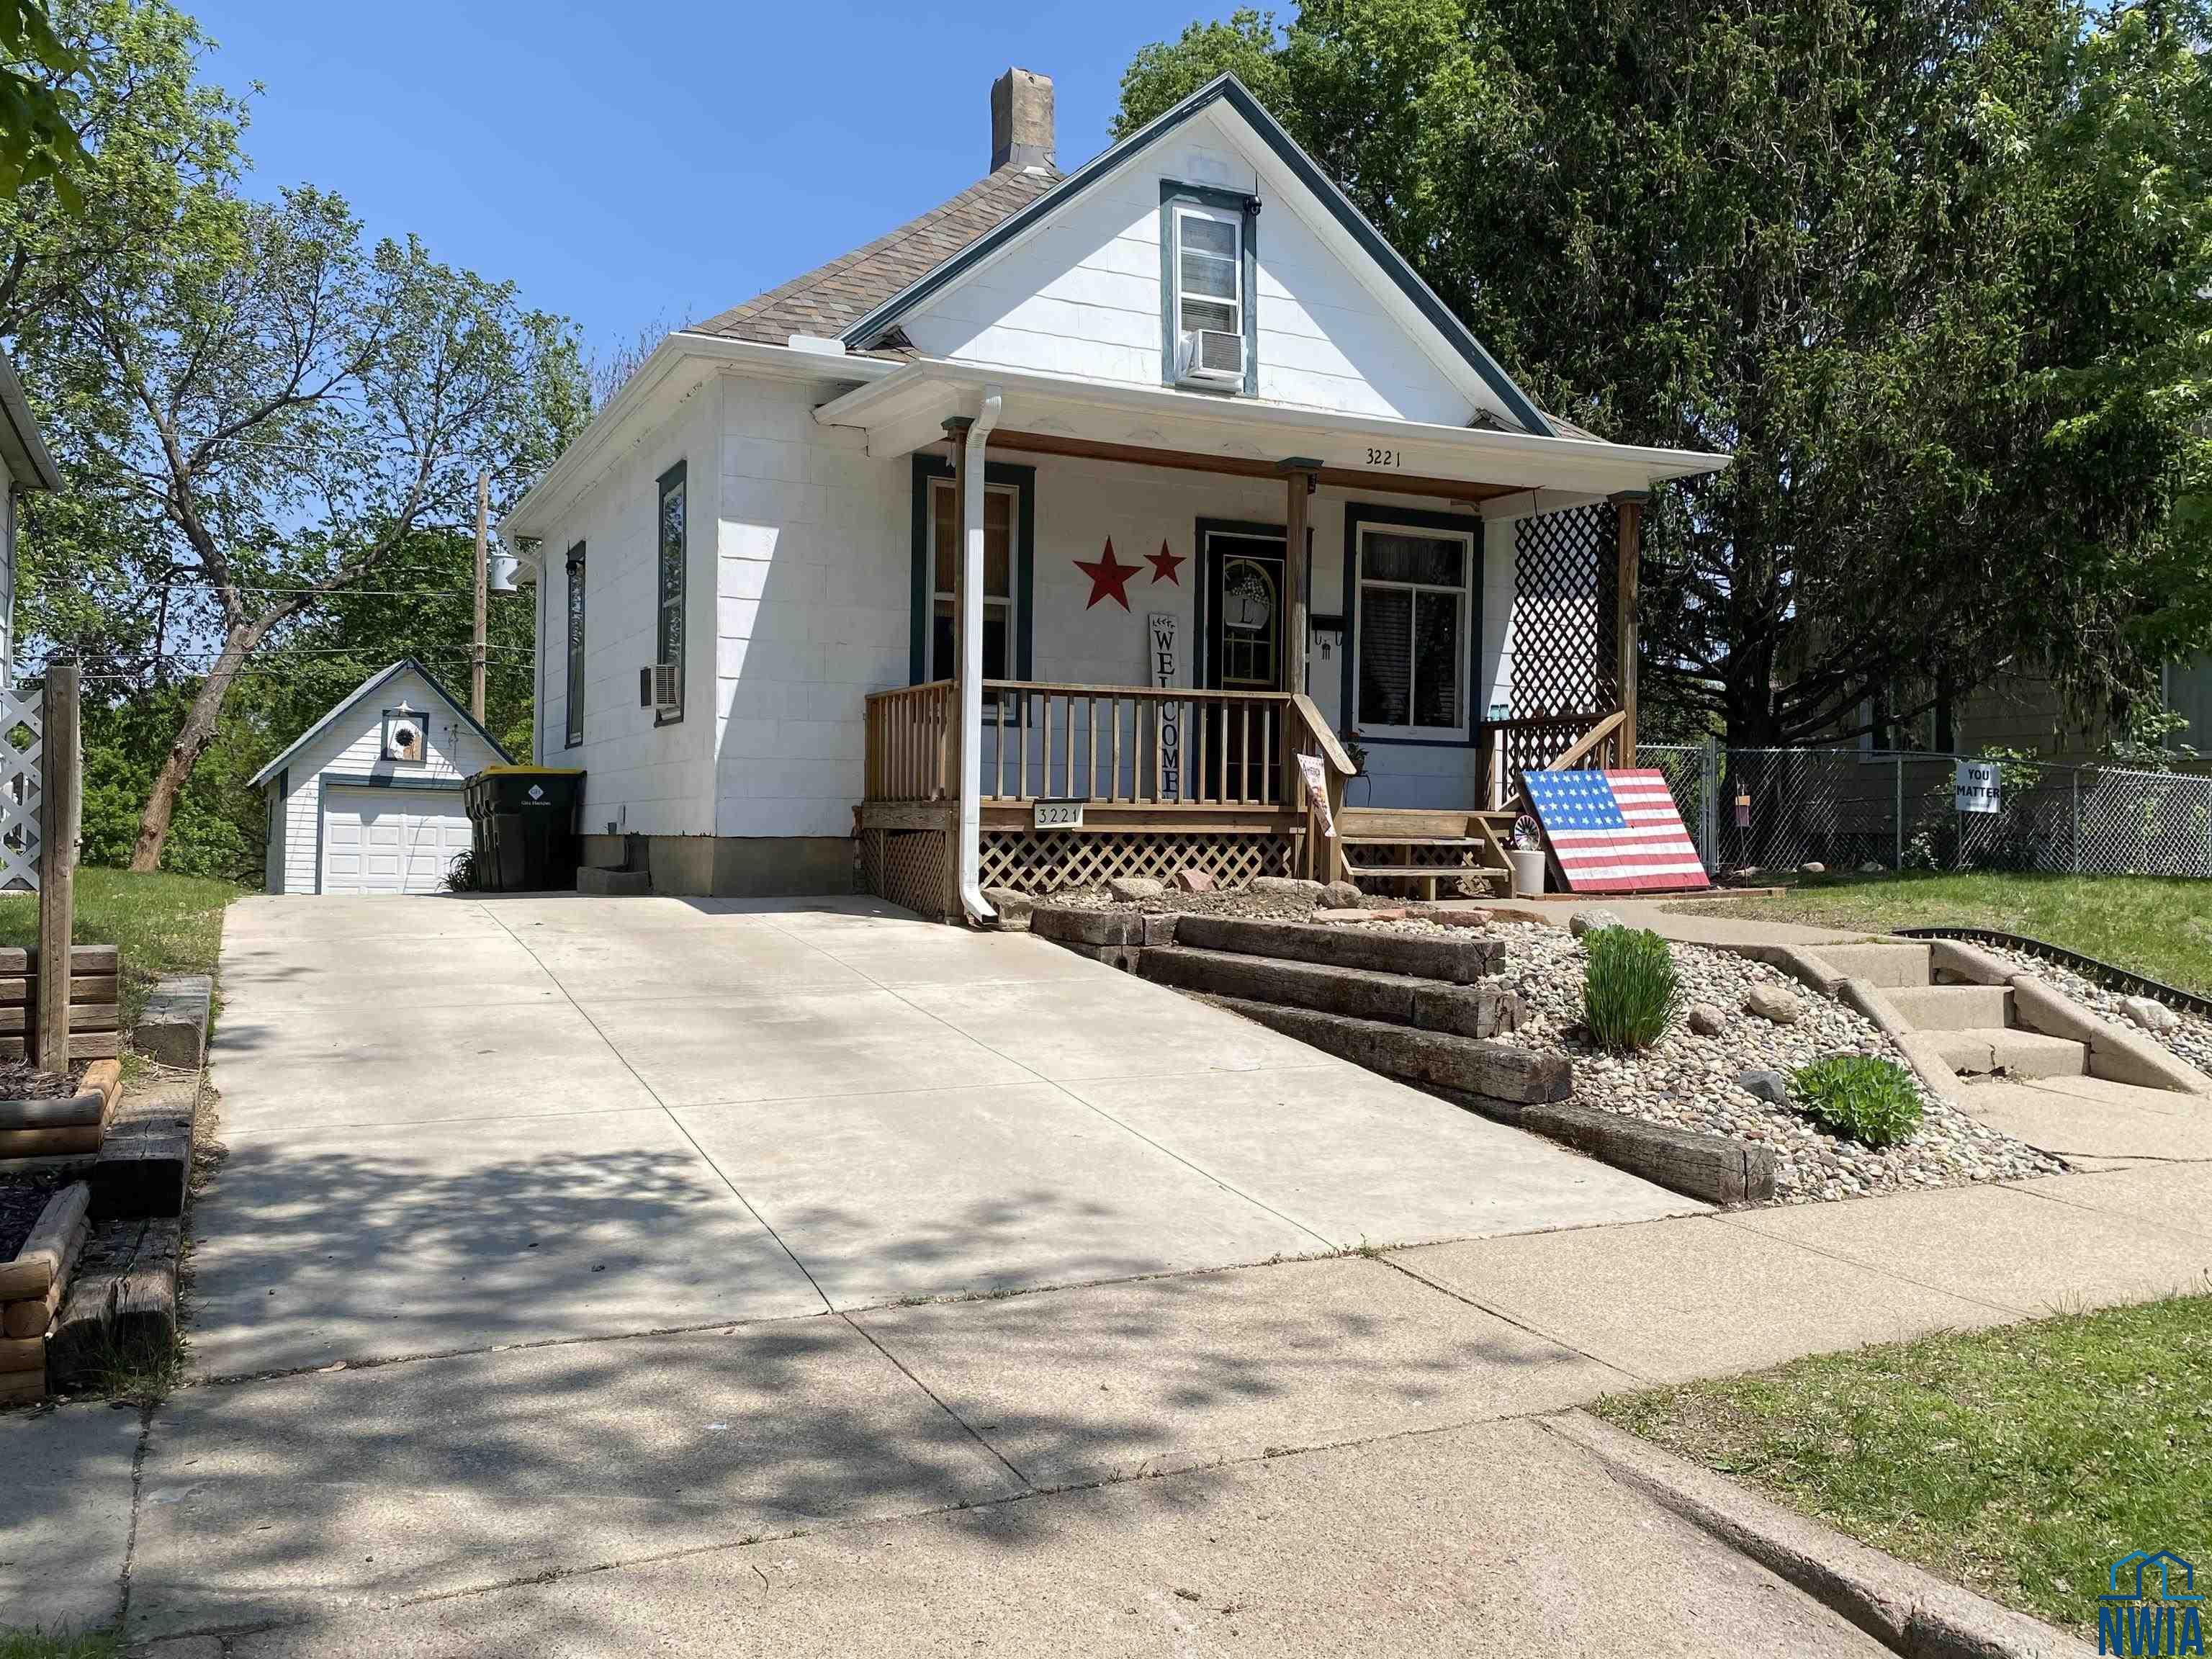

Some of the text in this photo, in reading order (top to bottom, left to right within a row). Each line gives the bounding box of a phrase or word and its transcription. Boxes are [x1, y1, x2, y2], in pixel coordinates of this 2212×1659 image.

[1366, 448, 1400, 468] 3221
[1968, 768, 1990, 781] YOU
[1957, 785, 2000, 799] MATTER
[1039, 808, 1076, 823] 3221
